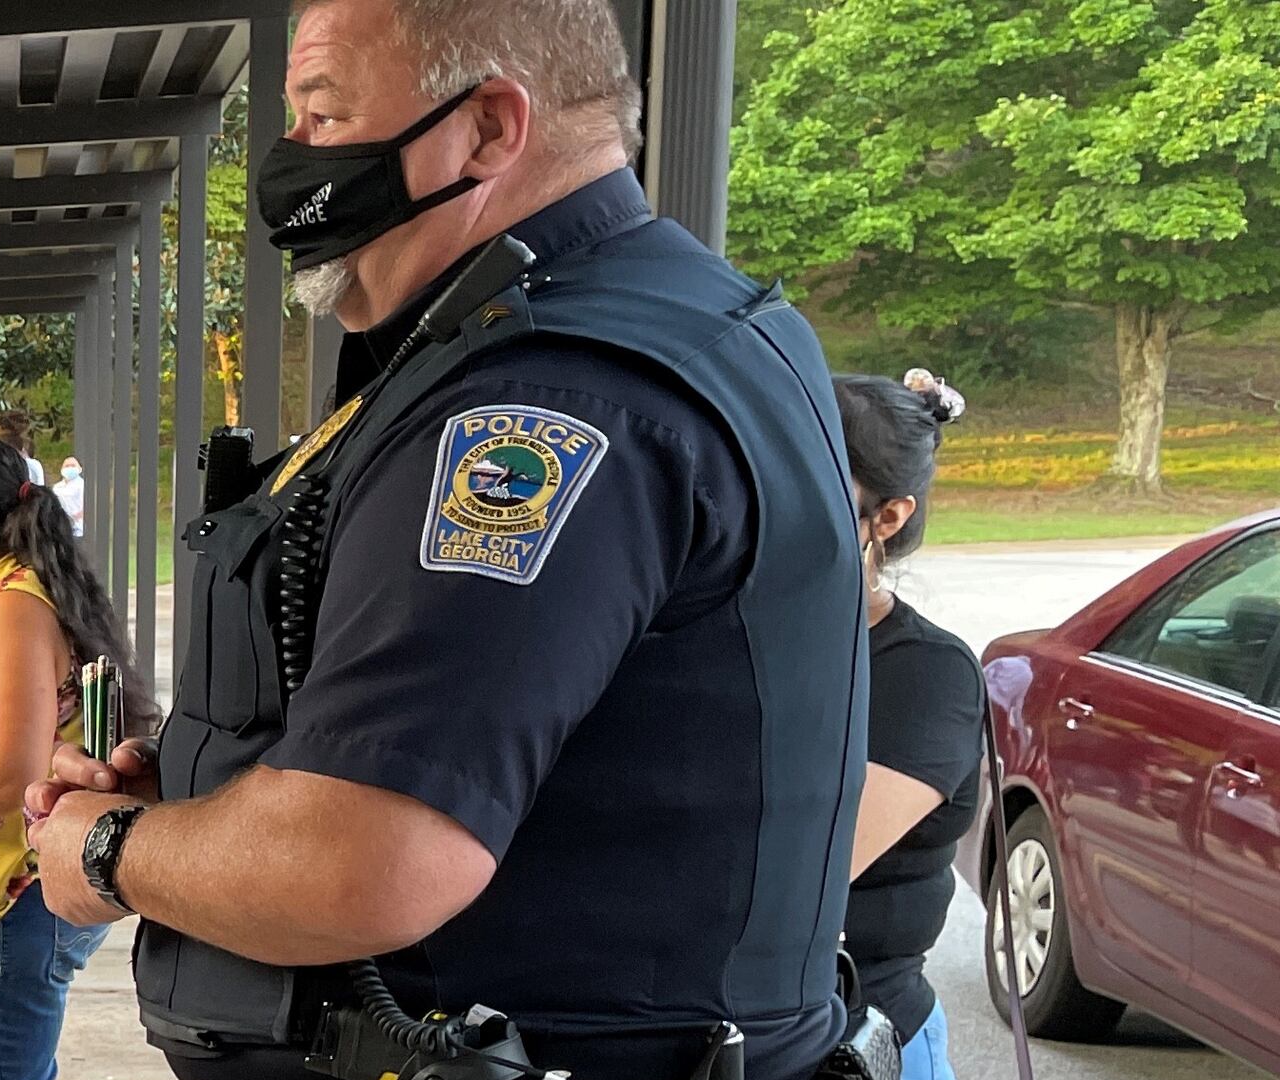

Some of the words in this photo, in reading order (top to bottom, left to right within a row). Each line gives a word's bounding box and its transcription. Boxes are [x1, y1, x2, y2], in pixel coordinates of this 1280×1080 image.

[286, 203, 327, 227] LICE
[464, 415, 589, 455] POLICE
[458, 458, 473, 473] THE
[470, 441, 490, 458] CITY
[492, 437, 505, 445] OF
[508, 436, 549, 455] FRIENDLY
[462, 496, 503, 517] FOUNDED
[507, 504, 532, 517] 1951
[455, 512, 480, 529] SERVE
[483, 524, 495, 533] TO
[496, 519, 540, 533] PROTECT
[438, 529, 485, 547] LAKE
[488, 536, 534, 556] CITY
[439, 544, 519, 571] GEORGIA
